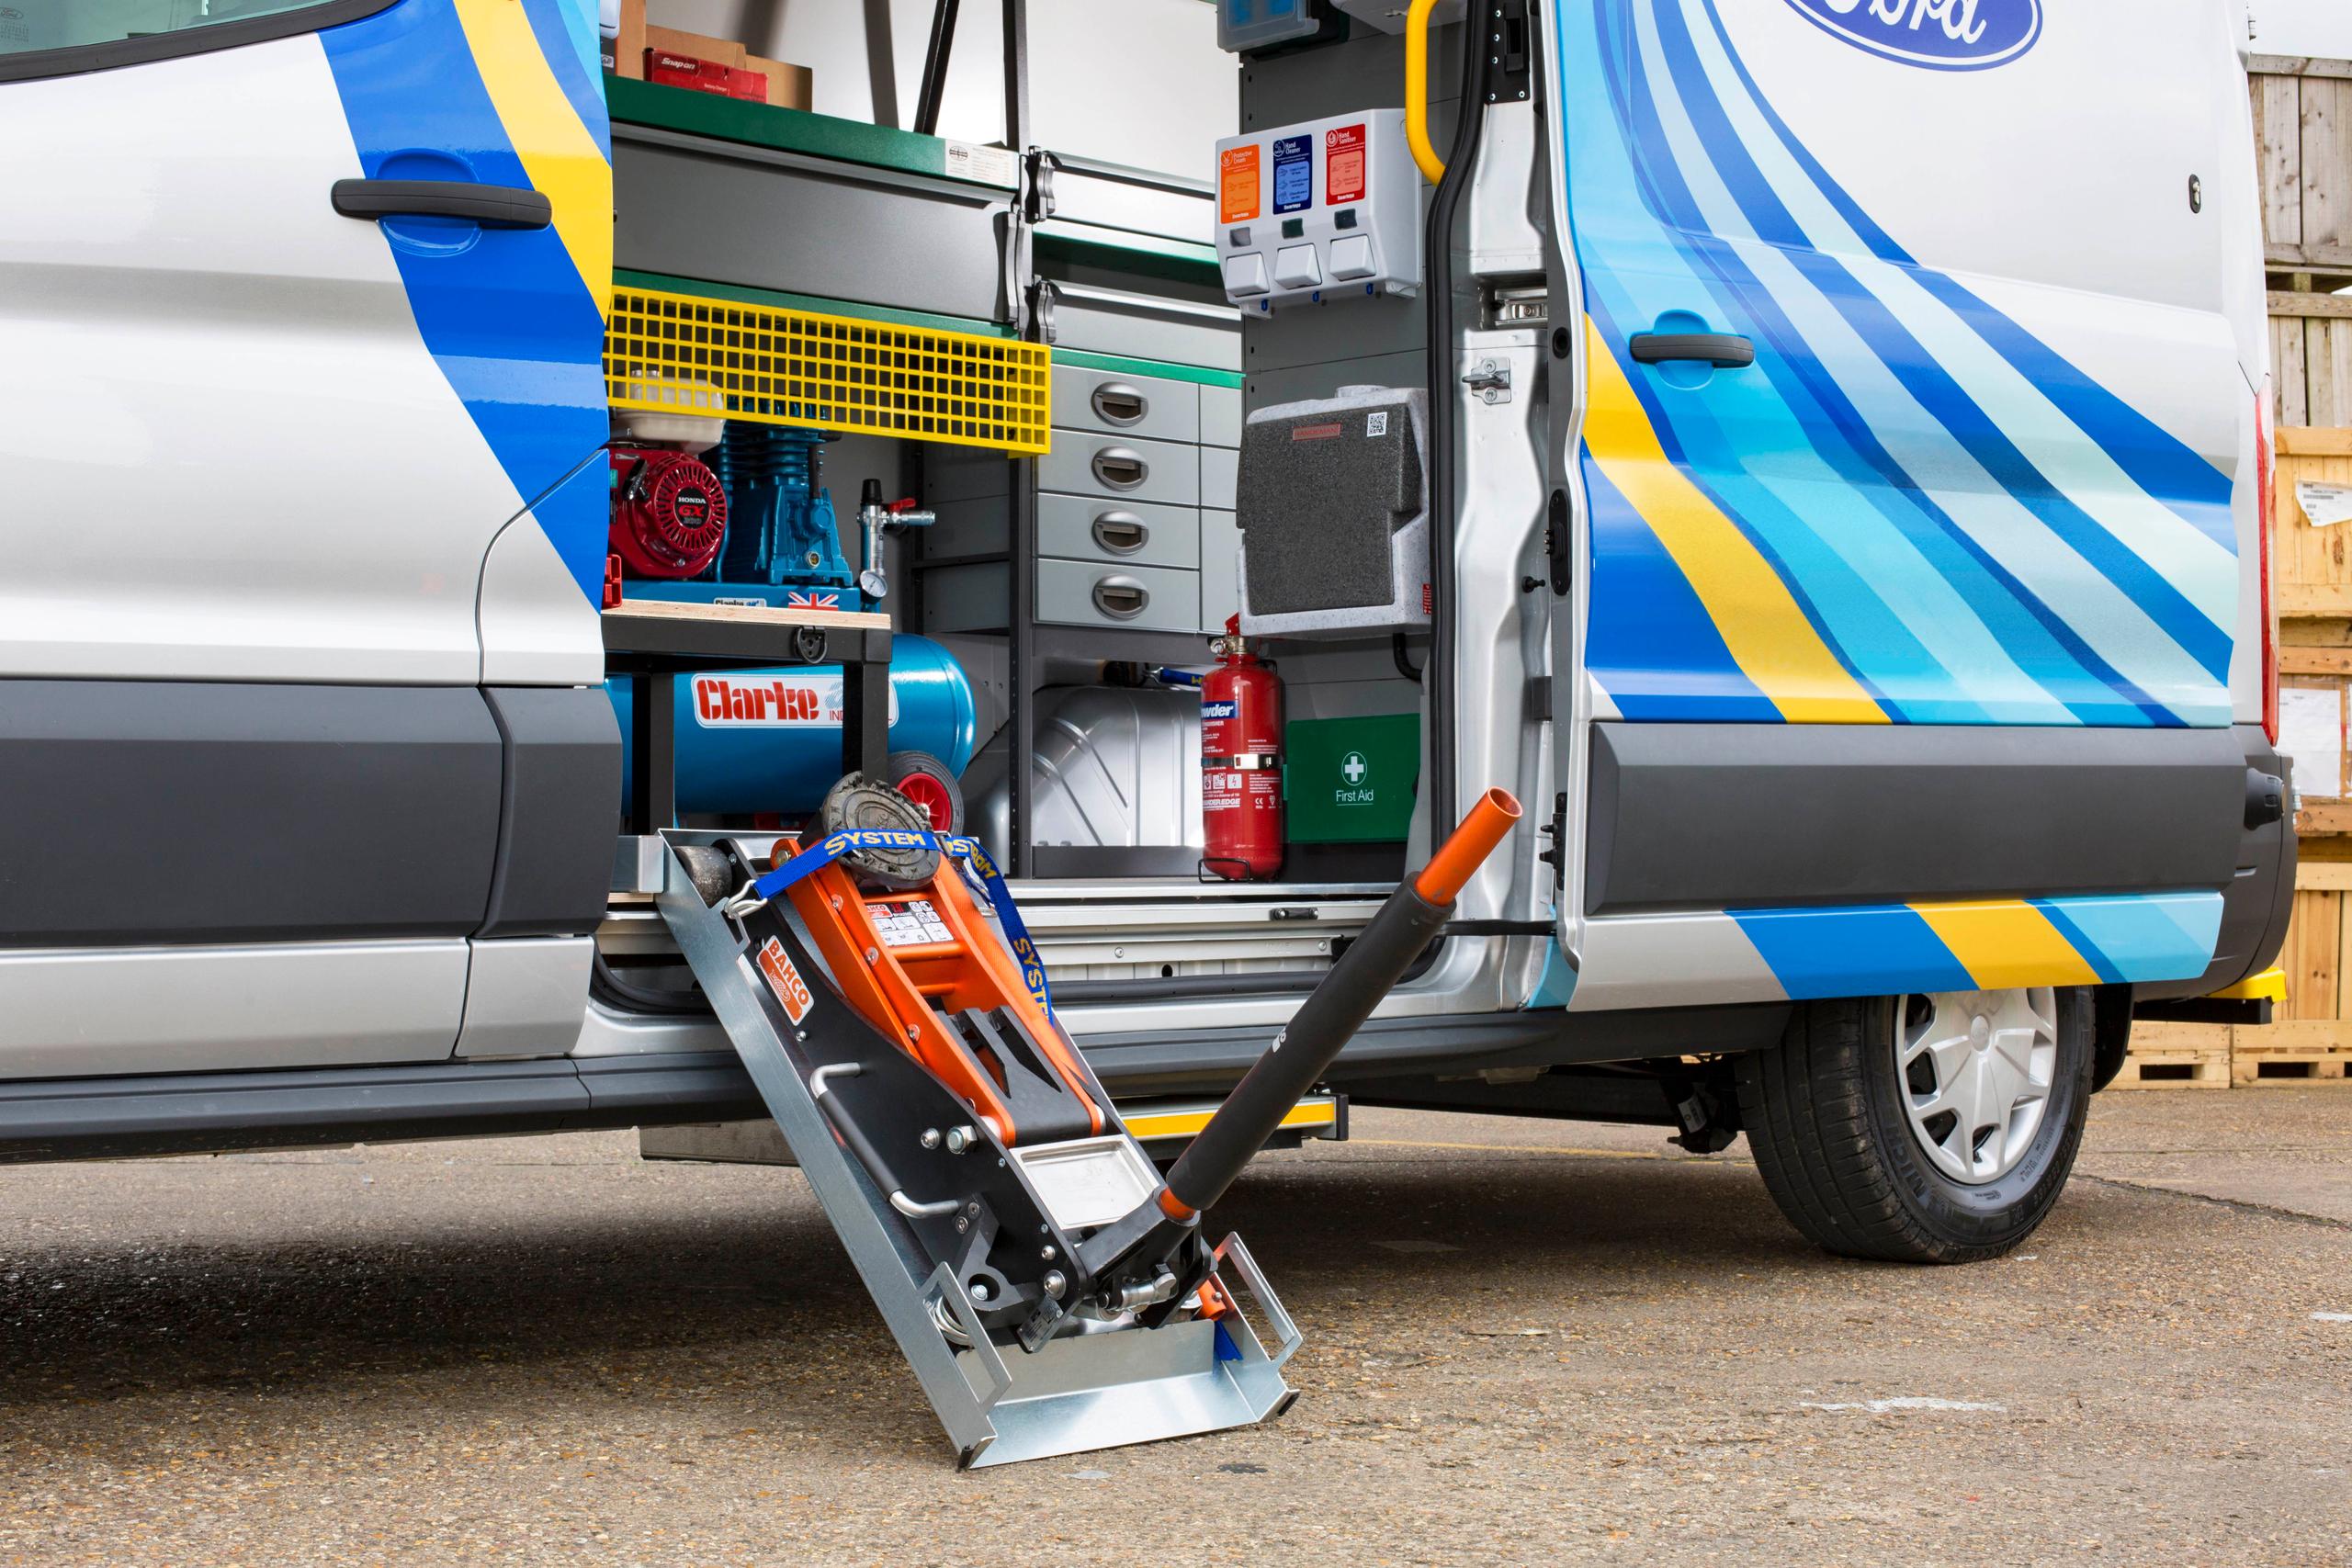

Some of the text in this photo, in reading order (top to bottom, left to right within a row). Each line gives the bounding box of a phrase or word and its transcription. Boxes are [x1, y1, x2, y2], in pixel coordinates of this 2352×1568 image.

[1823, 0, 1986, 44] ord
[678, 505, 705, 517] GX
[696, 680, 820, 720] Clarke
[1336, 789, 1374, 802] First Aid
[824, 831, 926, 856] SYSTEM
[768, 939, 809, 1006] BAHCO
